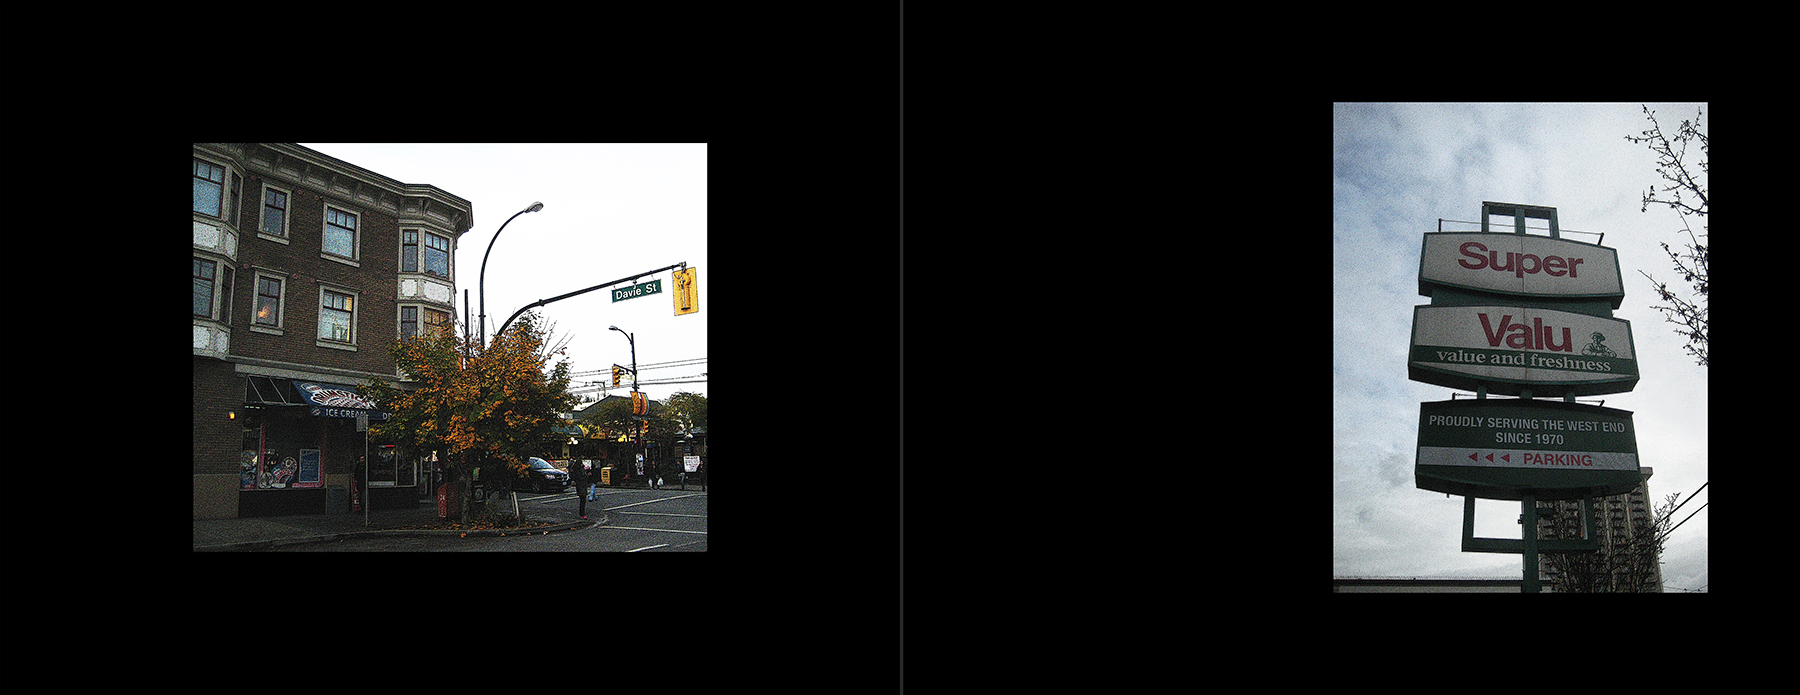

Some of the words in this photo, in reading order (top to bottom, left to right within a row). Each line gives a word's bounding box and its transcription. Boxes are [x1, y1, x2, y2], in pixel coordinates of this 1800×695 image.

[1458, 241, 1584, 278] Super
[615, 286, 642, 300] Davie
[645, 283, 657, 294] St
[1477, 313, 1573, 352] Valu
[1436, 349, 1486, 364] value
[1490, 350, 1526, 366] and
[1530, 353, 1612, 372] freshness
[325, 408, 338, 417] ICE
[1429, 415, 1484, 428] PROUDLY
[1487, 417, 1539, 430] SERVING
[1542, 419, 1565, 431] THE
[1566, 420, 1599, 432] WEST
[1602, 422, 1625, 433] END
[1495, 432, 1532, 444] SINCE
[1535, 433, 1564, 445] 1970
[1523, 452, 1593, 467] PARKING
